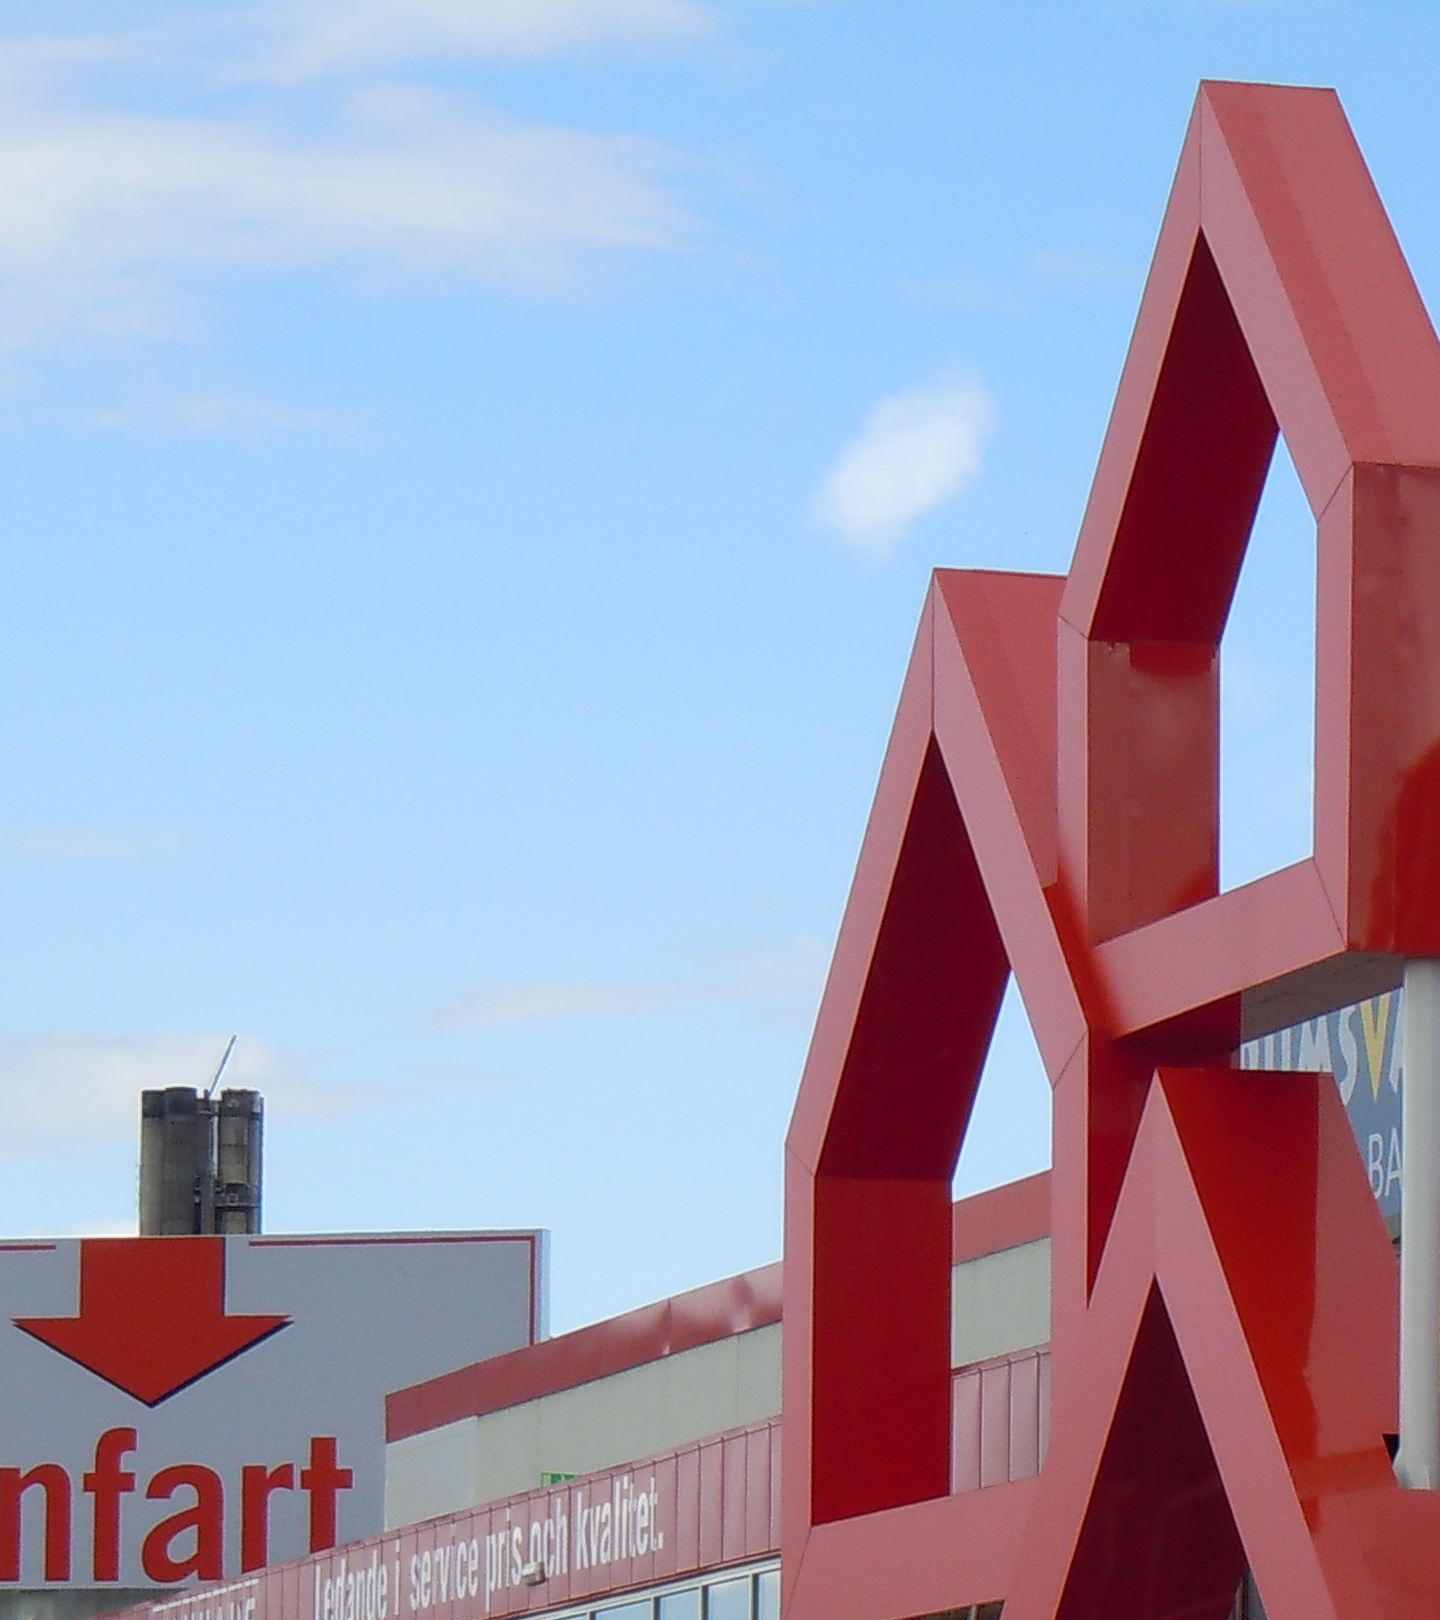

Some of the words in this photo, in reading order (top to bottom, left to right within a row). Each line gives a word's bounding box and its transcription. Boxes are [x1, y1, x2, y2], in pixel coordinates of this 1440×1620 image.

[394, 1539, 401, 1615] i
[408, 1520, 478, 1611] service
[485, 1507, 523, 1613] pris
[529, 1496, 568, 1579] och
